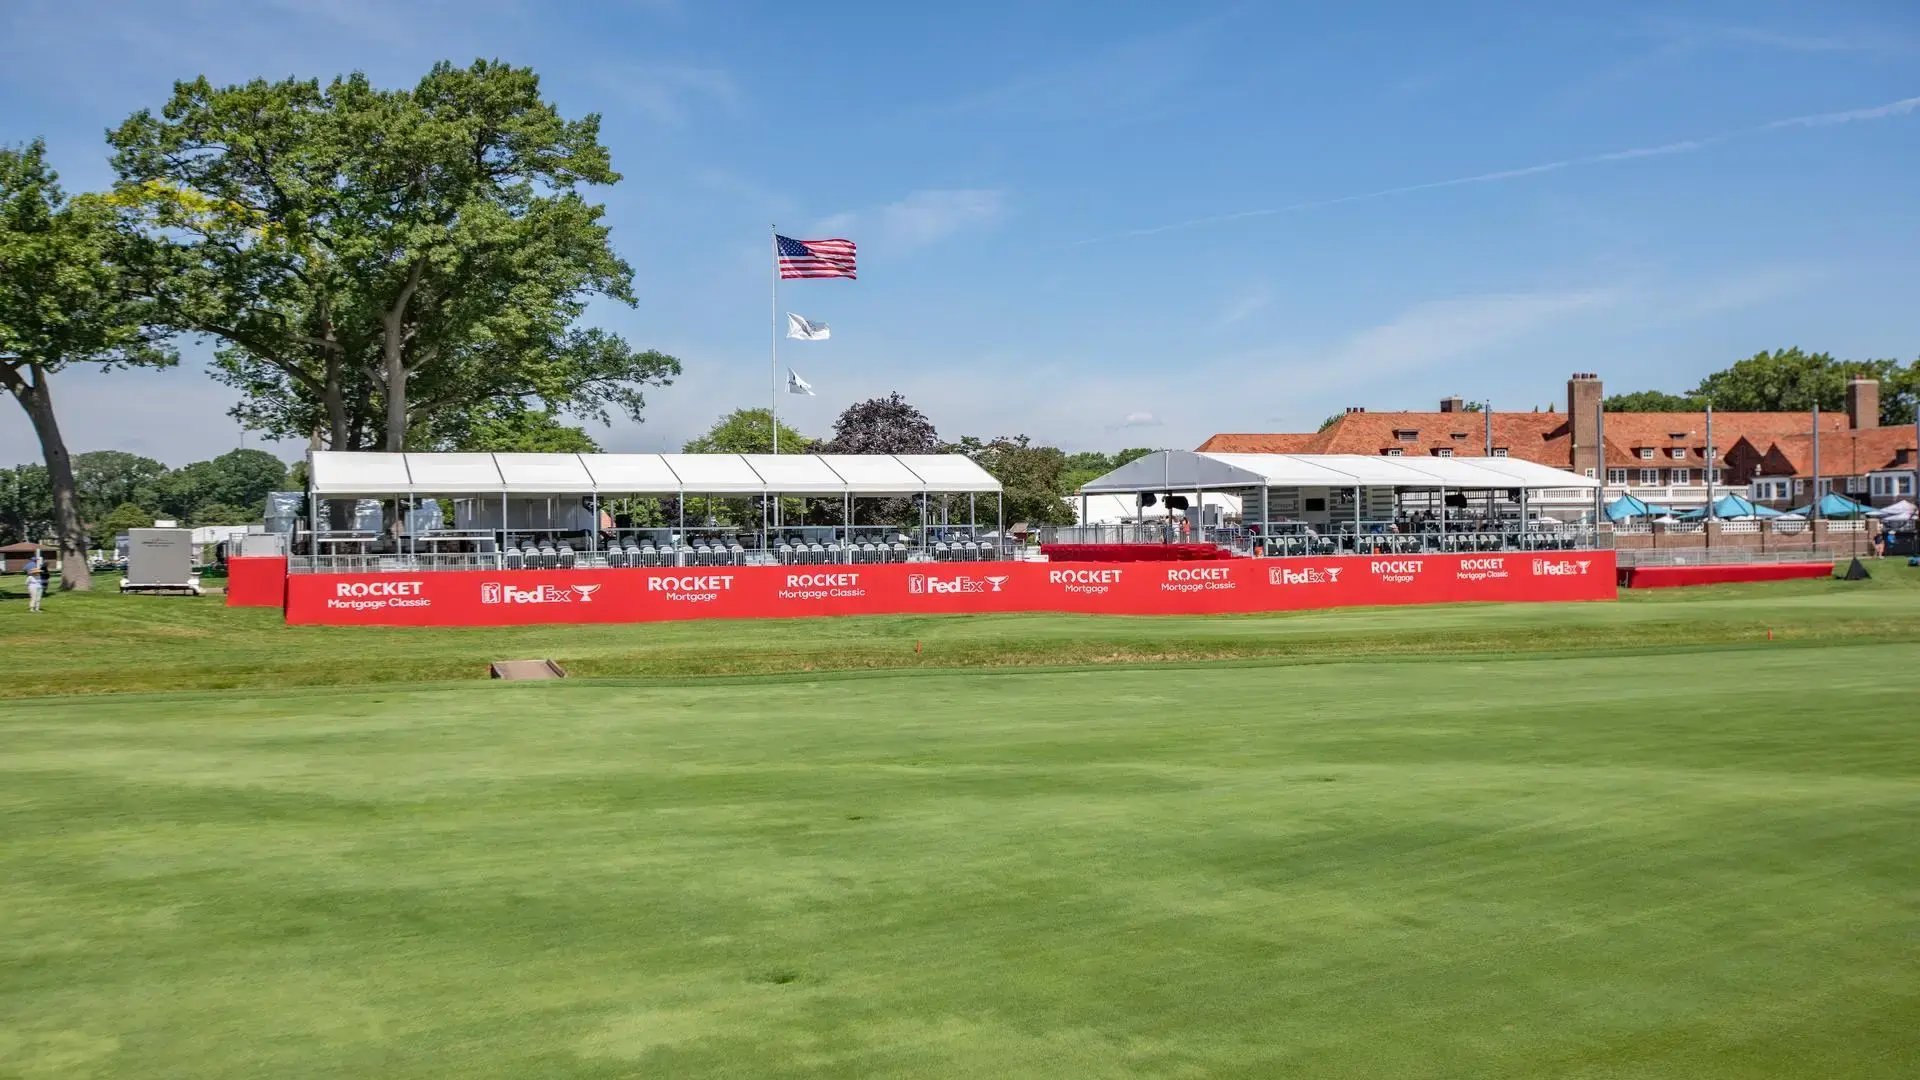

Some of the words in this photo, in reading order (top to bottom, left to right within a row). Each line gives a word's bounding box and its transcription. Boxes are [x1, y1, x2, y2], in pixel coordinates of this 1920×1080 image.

[1372, 560, 1423, 574] ROCKET
[1461, 558, 1504, 570] ROCKET
[1543, 560, 1577, 576] FedEx
[787, 573, 859, 588] ROCKET
[1050, 570, 1122, 583] ROCKET
[1168, 568, 1229, 581] ROCKET
[1283, 568, 1325, 584] FedEx
[1383, 574, 1413, 583] Mortgage
[1457, 571, 1486, 581] Mortgage
[1487, 570, 1508, 578] Classic
[337, 581, 424, 598] ROCKET
[649, 576, 733, 591] ROCKET
[928, 576, 984, 593] FedEx
[1066, 585, 1108, 594] Mortgage
[1161, 584, 1203, 593] Mortgage
[1206, 582, 1235, 590] Classic
[504, 584, 571, 604] FedEx
[667, 593, 717, 603] Mortgage
[779, 589, 827, 600] Mortgage
[830, 588, 865, 597] Classic
[328, 600, 386, 610] Mortgage
[389, 598, 430, 607] Classic
